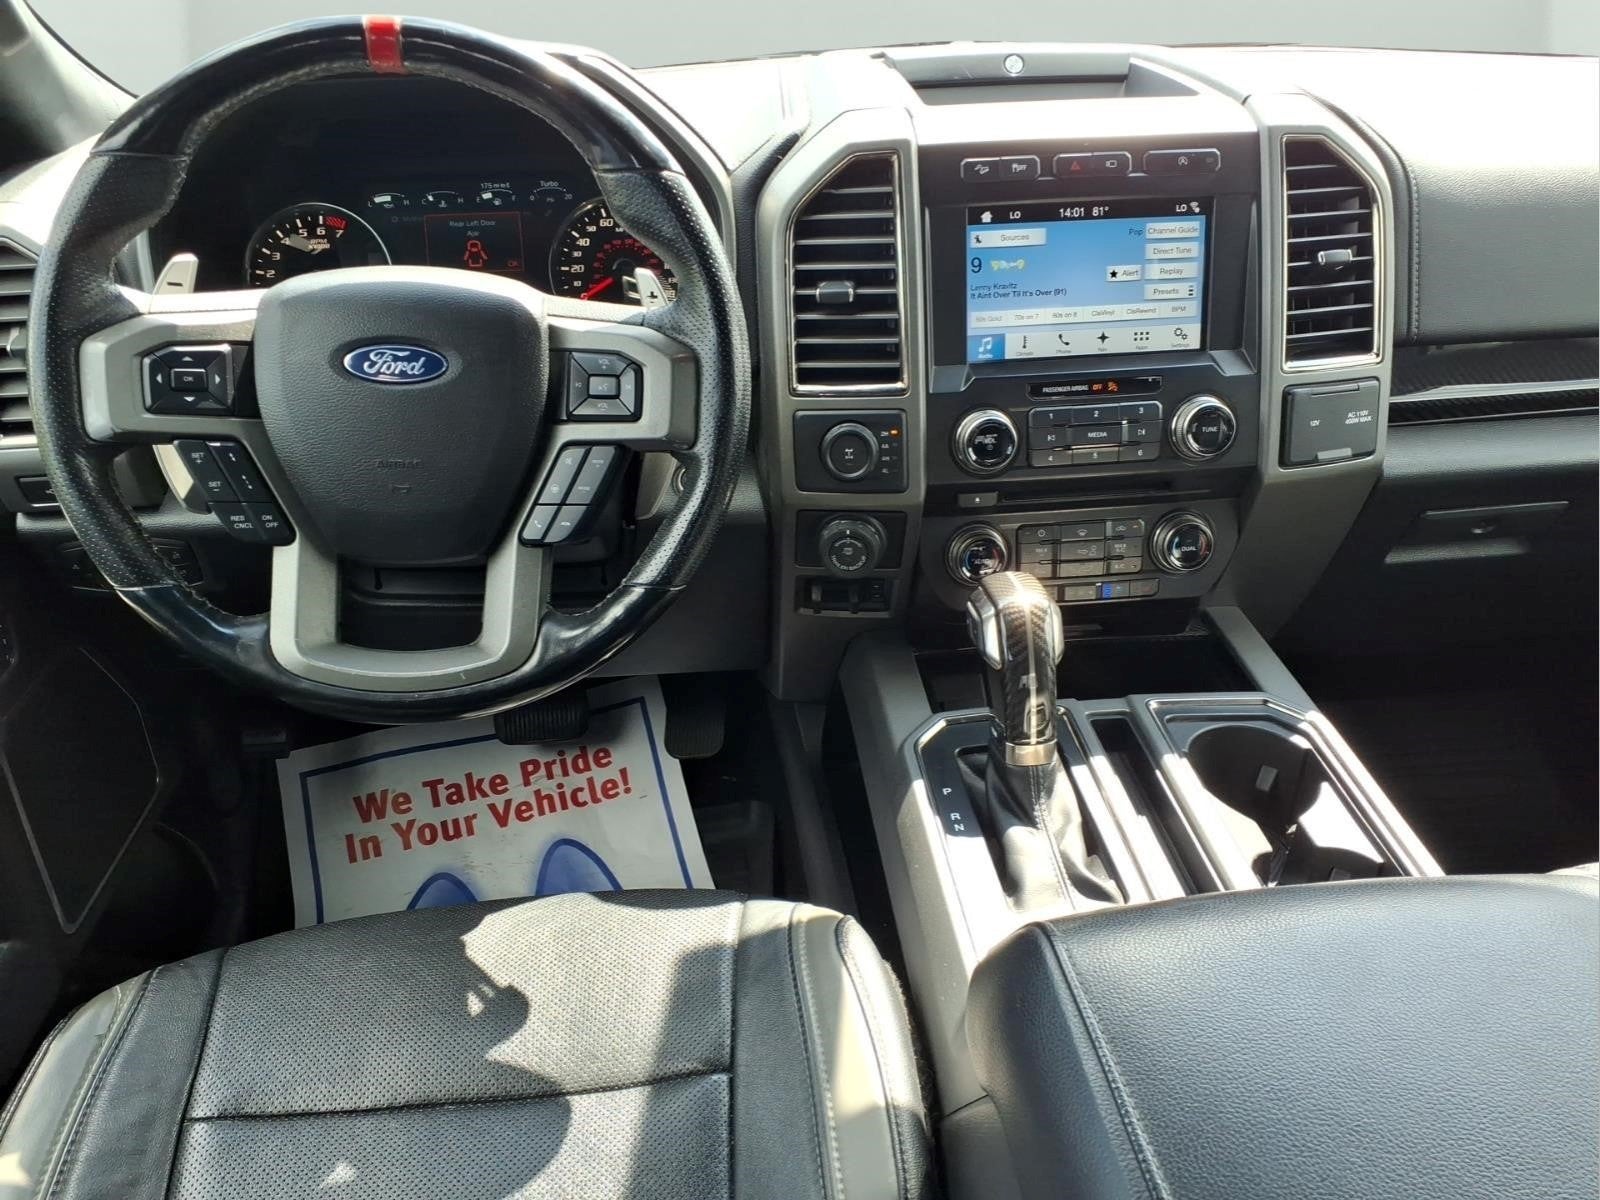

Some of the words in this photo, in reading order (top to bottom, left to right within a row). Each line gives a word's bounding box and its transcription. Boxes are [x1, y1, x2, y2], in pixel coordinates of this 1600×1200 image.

[1175, 204, 1187, 212] LO
[1009, 211, 1021, 219] LO
[1059, 207, 1085, 218] 14:01
[599, 218, 613, 226] 60
[299, 229, 308, 237] 5
[316, 226, 326, 235] 6
[336, 229, 344, 238] 7
[1128, 228, 1143, 236] Pop
[1148, 226, 1176, 235] Channel
[1178, 225, 1198, 234] Guide
[1000, 233, 1030, 242] Sources
[576, 238, 590, 246] 40
[1153, 247, 1173, 255] Direct
[1176, 246, 1192, 254] Tune
[272, 252, 280, 260] 3
[570, 265, 585, 273] 20
[971, 257, 982, 274] 9
[266, 269, 276, 278] 2
[1121, 269, 1139, 277] Alert
[1159, 267, 1184, 276] Replay
[993, 290, 1011, 298] Over
[1022, 289, 1033, 297] It's
[1035, 288, 1052, 296] Over
[1053, 287, 1067, 297] (91)
[1153, 287, 1179, 295] Presets
[363, 350, 427, 375] Ford
[1042, 385, 1070, 393] PASSENGER
[353, 789, 413, 823] We
[422, 772, 509, 808] Take
[520, 745, 613, 787] Pride
[943, 787, 952, 795] P
[345, 833, 382, 864] In
[391, 813, 477, 850] Your
[487, 767, 632, 828] Vehicle!
[951, 812, 960, 820] R
